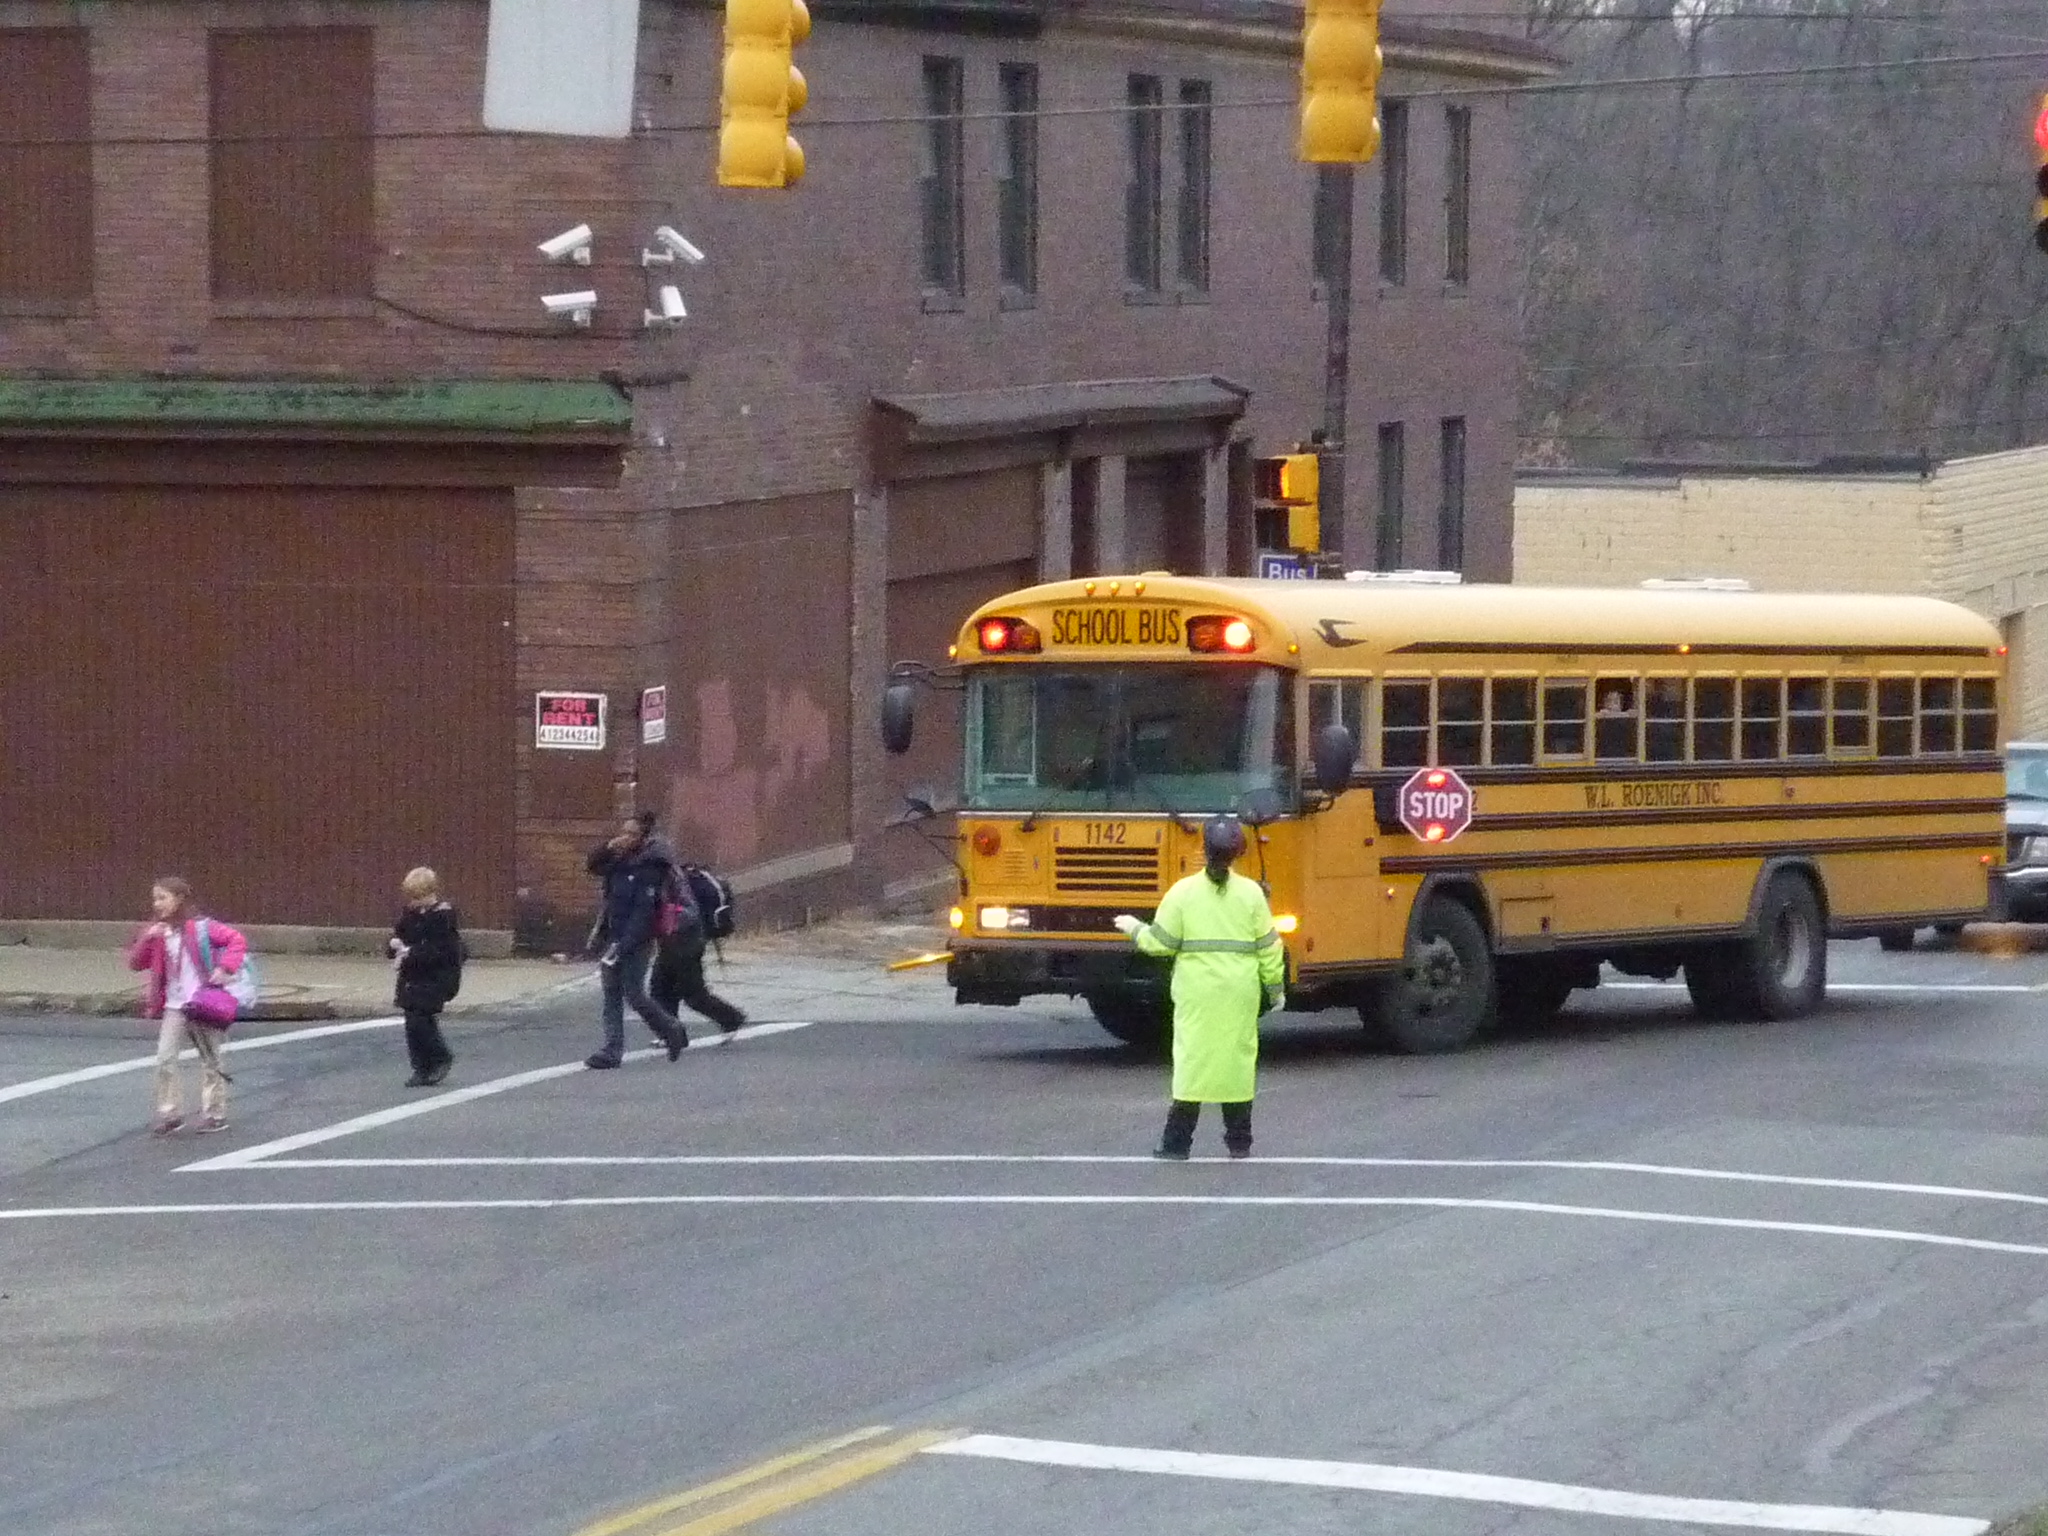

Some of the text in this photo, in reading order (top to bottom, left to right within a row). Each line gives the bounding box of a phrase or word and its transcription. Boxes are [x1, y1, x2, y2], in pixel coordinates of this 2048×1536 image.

[1268, 562, 1308, 580] Bus
[1052, 608, 1181, 645] SCHOOL BUS
[551, 699, 588, 713] FOR
[542, 711, 597, 726] RENT
[1409, 791, 1464, 820] STOP
[1085, 822, 1127, 845] 1142
